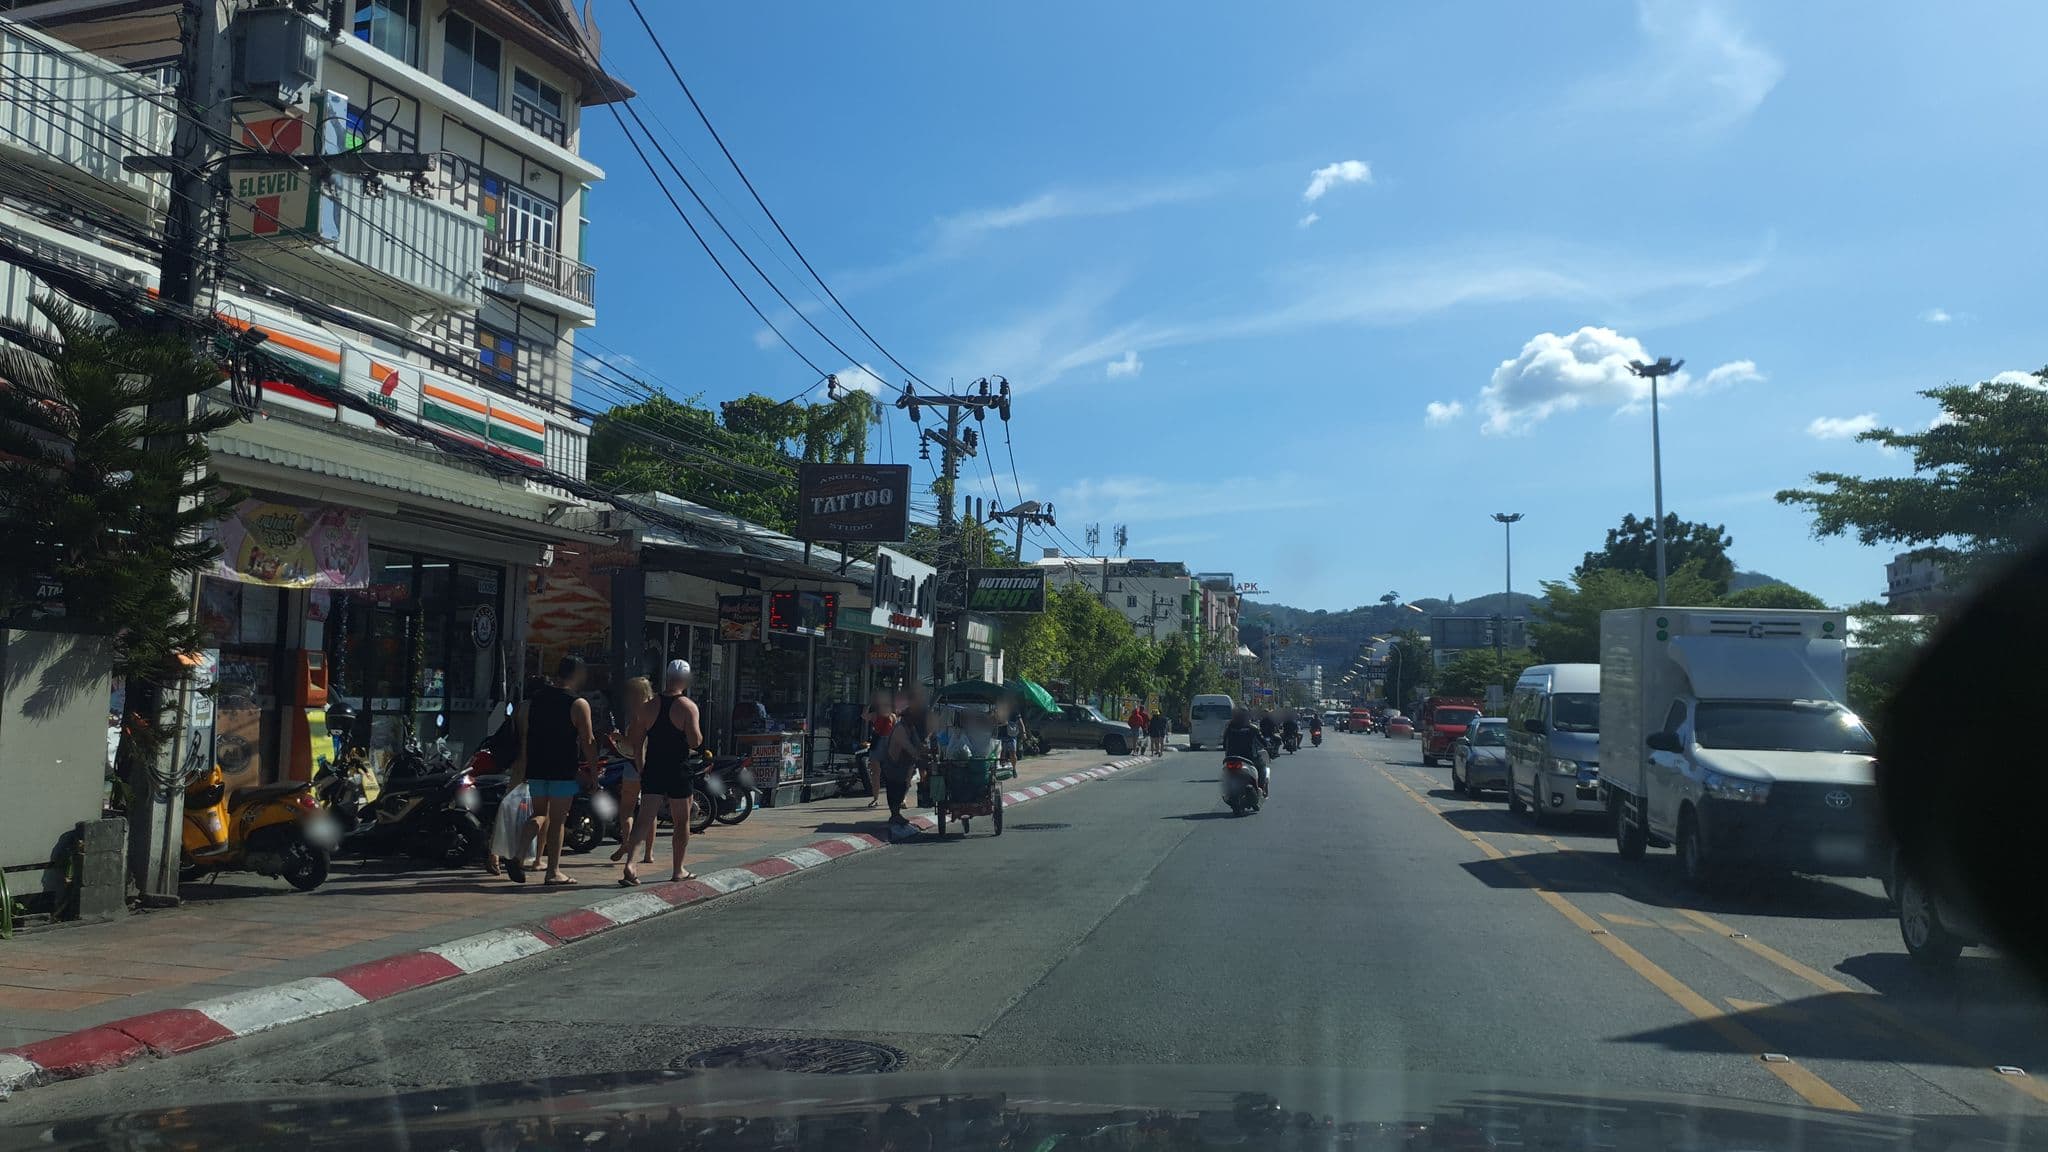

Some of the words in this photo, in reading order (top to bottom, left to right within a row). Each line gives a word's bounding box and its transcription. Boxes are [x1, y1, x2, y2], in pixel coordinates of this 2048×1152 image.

[810, 487, 894, 515] TATTOO
[828, 521, 873, 532] STUDIO
[978, 577, 1040, 589] NUTRITION
[1236, 582, 1258, 591] APK
[970, 589, 1034, 608] DEPOT
[753, 745, 780, 757] LAUNDRY
